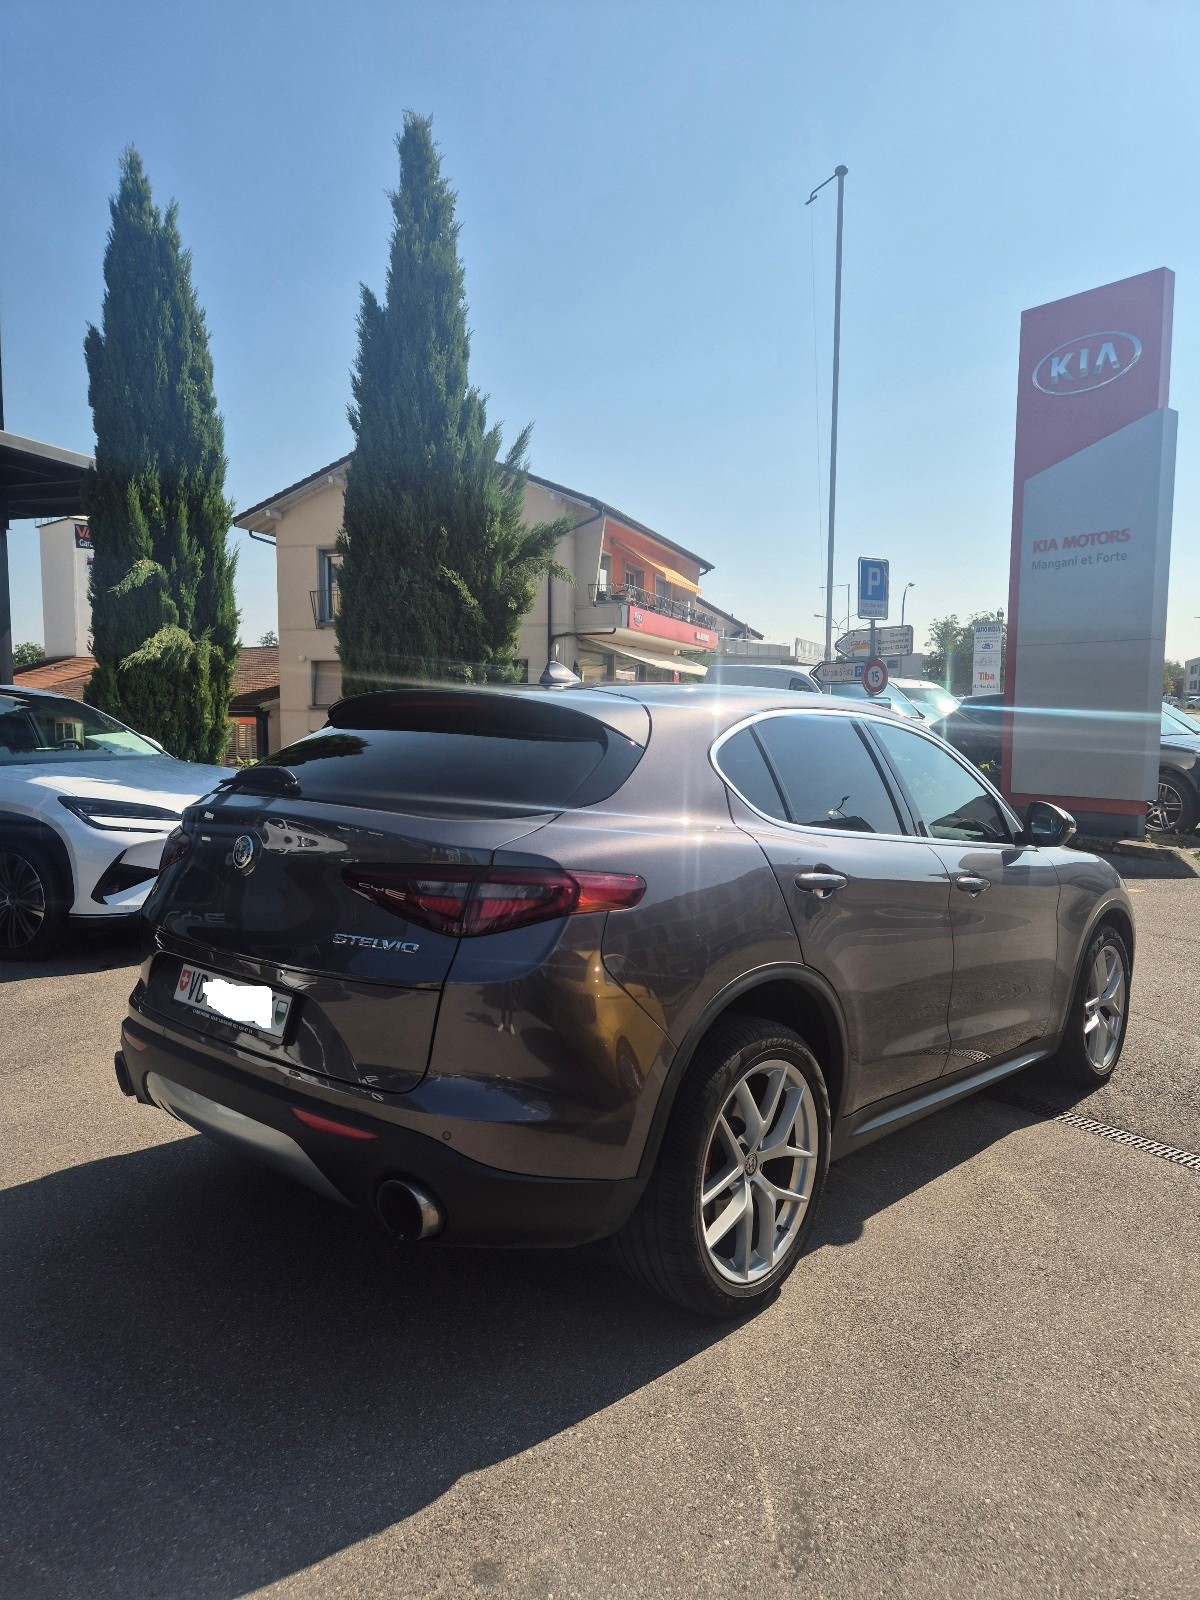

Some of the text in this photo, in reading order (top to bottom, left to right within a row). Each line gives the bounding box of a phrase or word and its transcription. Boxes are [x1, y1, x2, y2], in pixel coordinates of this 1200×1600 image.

[1050, 341, 1121, 387] KIA
[1033, 528, 1132, 554] KIA MOTORS
[1031, 551, 1129, 572] Mangani et Forte
[867, 567, 881, 596] P
[870, 671, 880, 683] 15
[978, 671, 996, 681] Tiba
[332, 932, 420, 955] STELVIO
